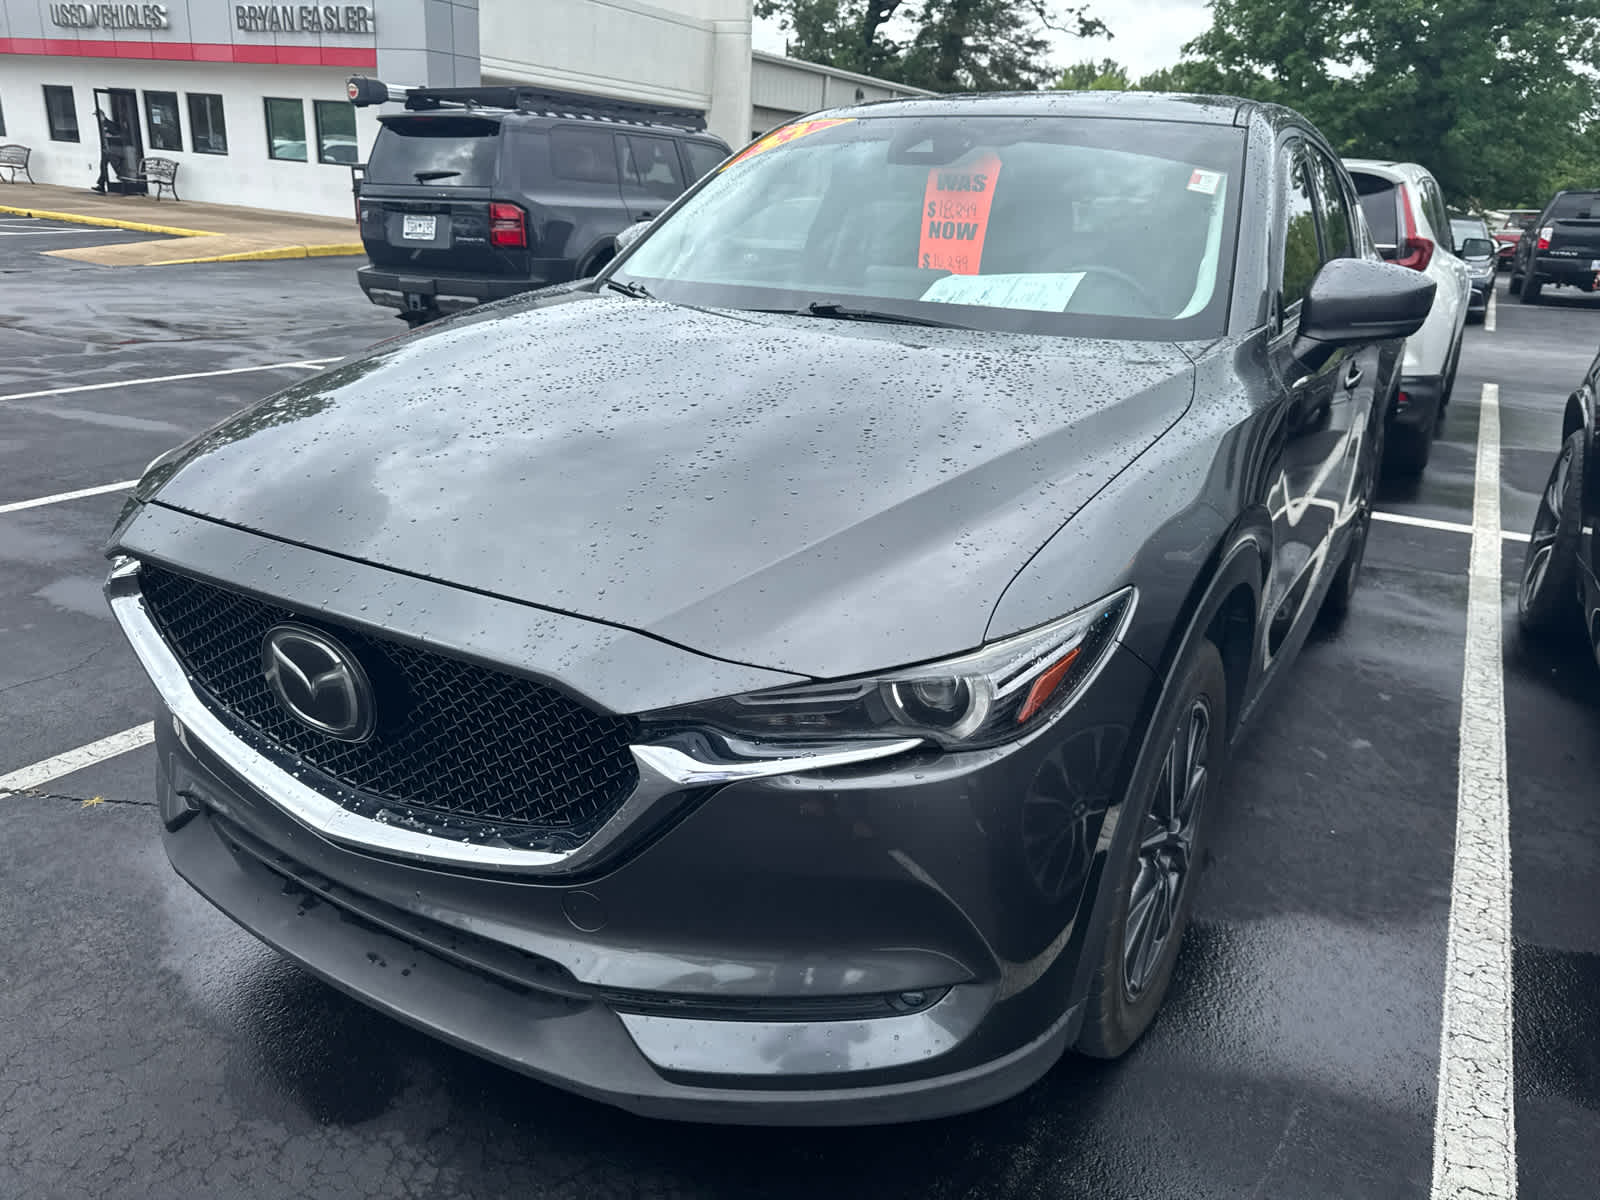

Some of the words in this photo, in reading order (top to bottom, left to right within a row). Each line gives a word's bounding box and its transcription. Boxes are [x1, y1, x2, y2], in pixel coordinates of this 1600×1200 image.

[49, 4, 88, 26] USED
[90, 4, 165, 29] VEHICLES
[235, 5, 295, 32] BRYAN
[299, 6, 371, 33] EASLER
[937, 173, 988, 192] WAS
[928, 221, 979, 240] NOW
